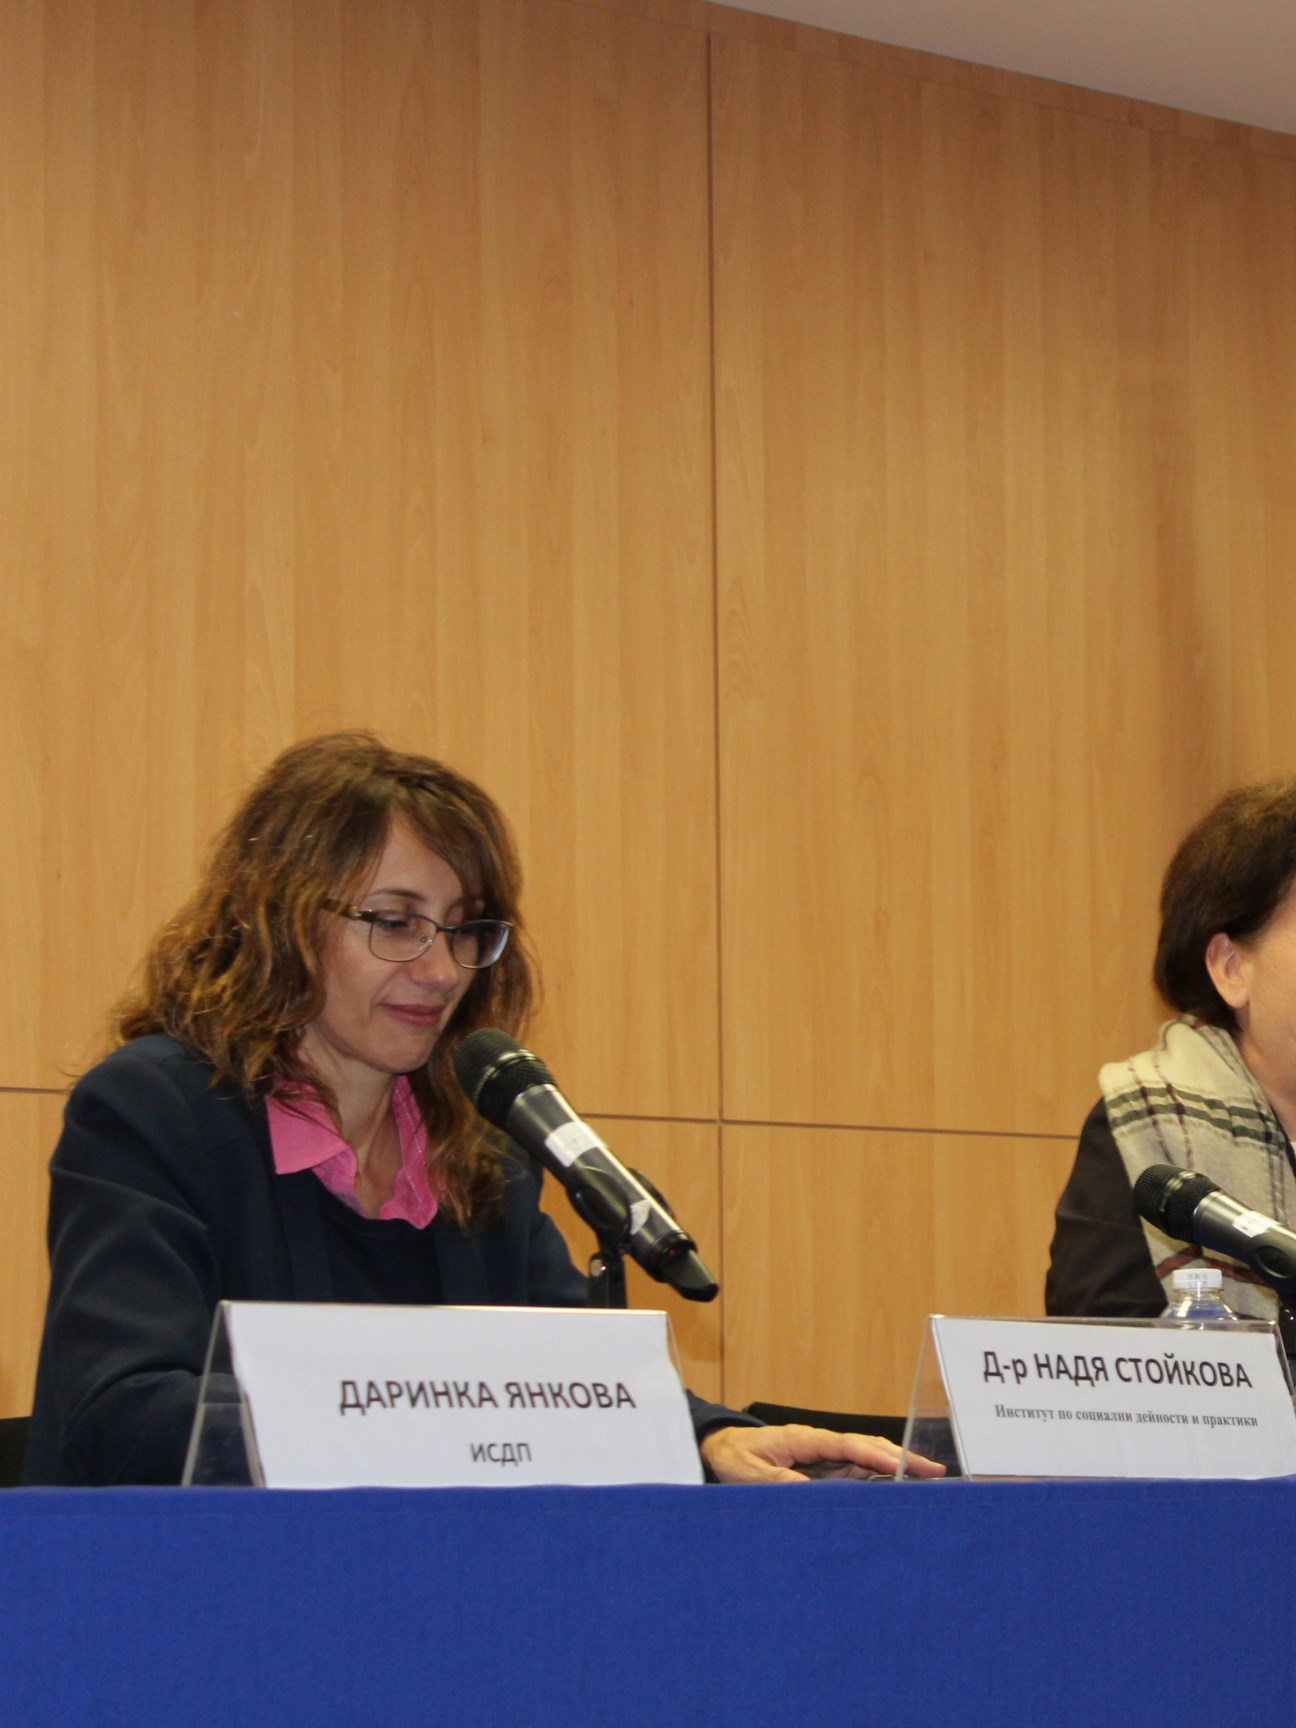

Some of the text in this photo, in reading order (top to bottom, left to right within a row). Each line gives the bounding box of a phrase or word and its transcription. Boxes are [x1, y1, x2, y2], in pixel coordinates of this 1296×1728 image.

[983, 1351, 1253, 1388] Д-р НАДЯ СТОЙКОВА
[339, 1380, 636, 1416] ДАРИНКА ЯНКОВА
[994, 1404, 1258, 1428] Институт по социални дейности и практики
[470, 1443, 532, 1467] ИСДП
